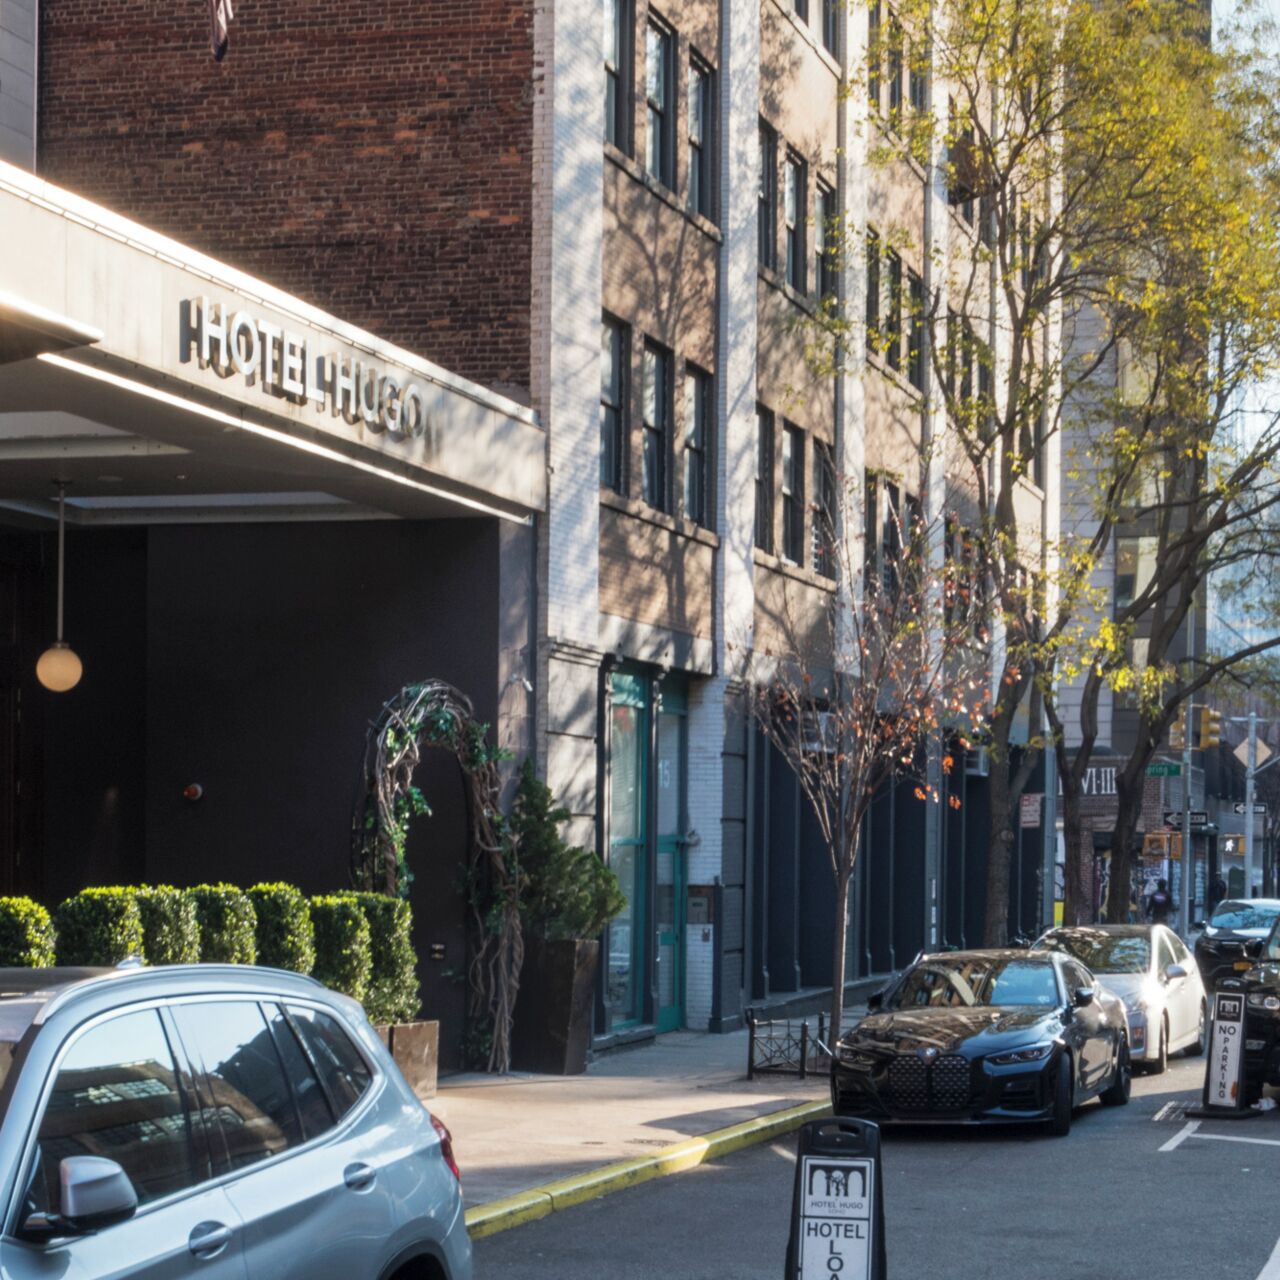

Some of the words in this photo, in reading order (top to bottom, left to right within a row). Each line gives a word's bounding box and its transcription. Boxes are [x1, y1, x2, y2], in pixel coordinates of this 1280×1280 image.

[201, 295, 325, 403] HOTEL
[337, 351, 424, 439] HUGO
[1218, 1025, 1237, 1036] NO
[1219, 1037, 1230, 1098] PARKING
[840, 1202, 864, 1210] HUGO
[807, 1222, 865, 1239] HOTEL
